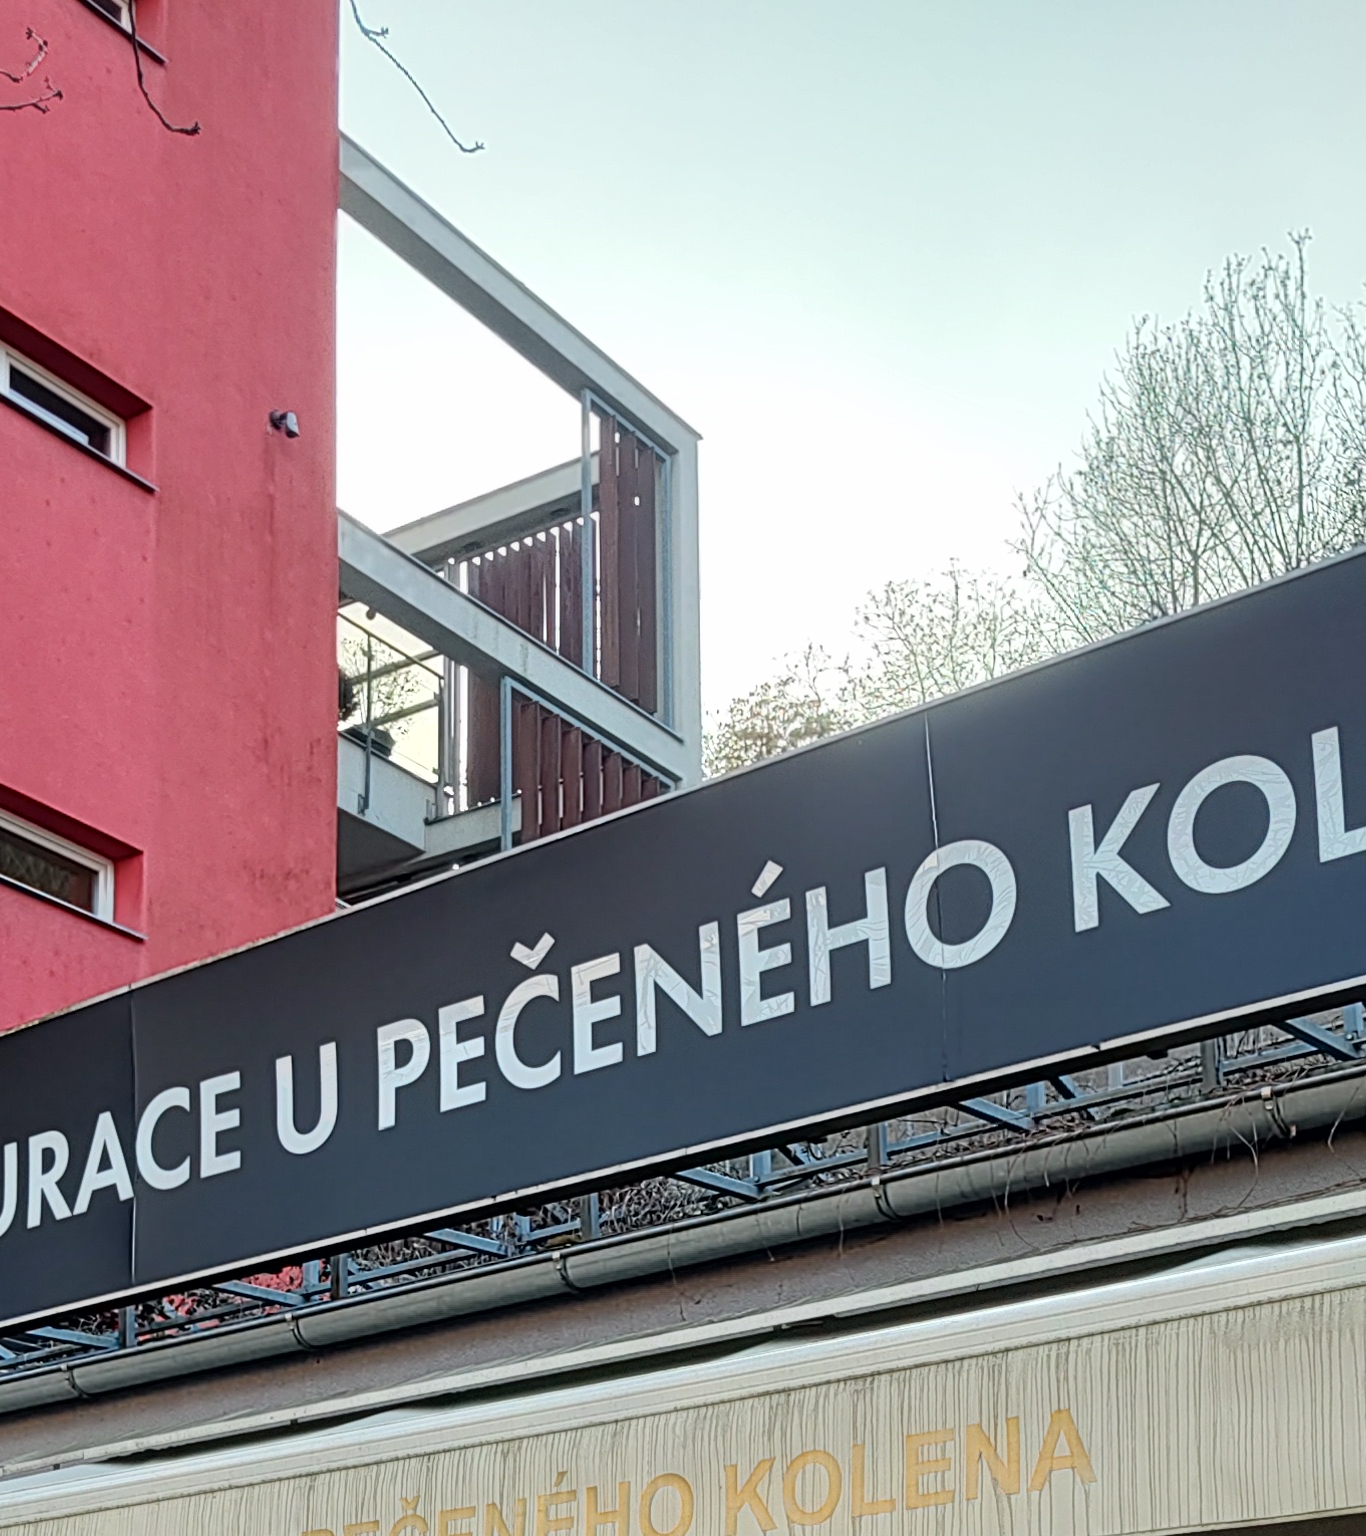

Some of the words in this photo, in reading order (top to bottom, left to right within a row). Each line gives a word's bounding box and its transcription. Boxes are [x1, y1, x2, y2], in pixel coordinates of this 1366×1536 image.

[275, 1042, 338, 1155] U
[377, 837, 1017, 1131] PEČENÉHO
[723, 1409, 1092, 1536] KOLENA
